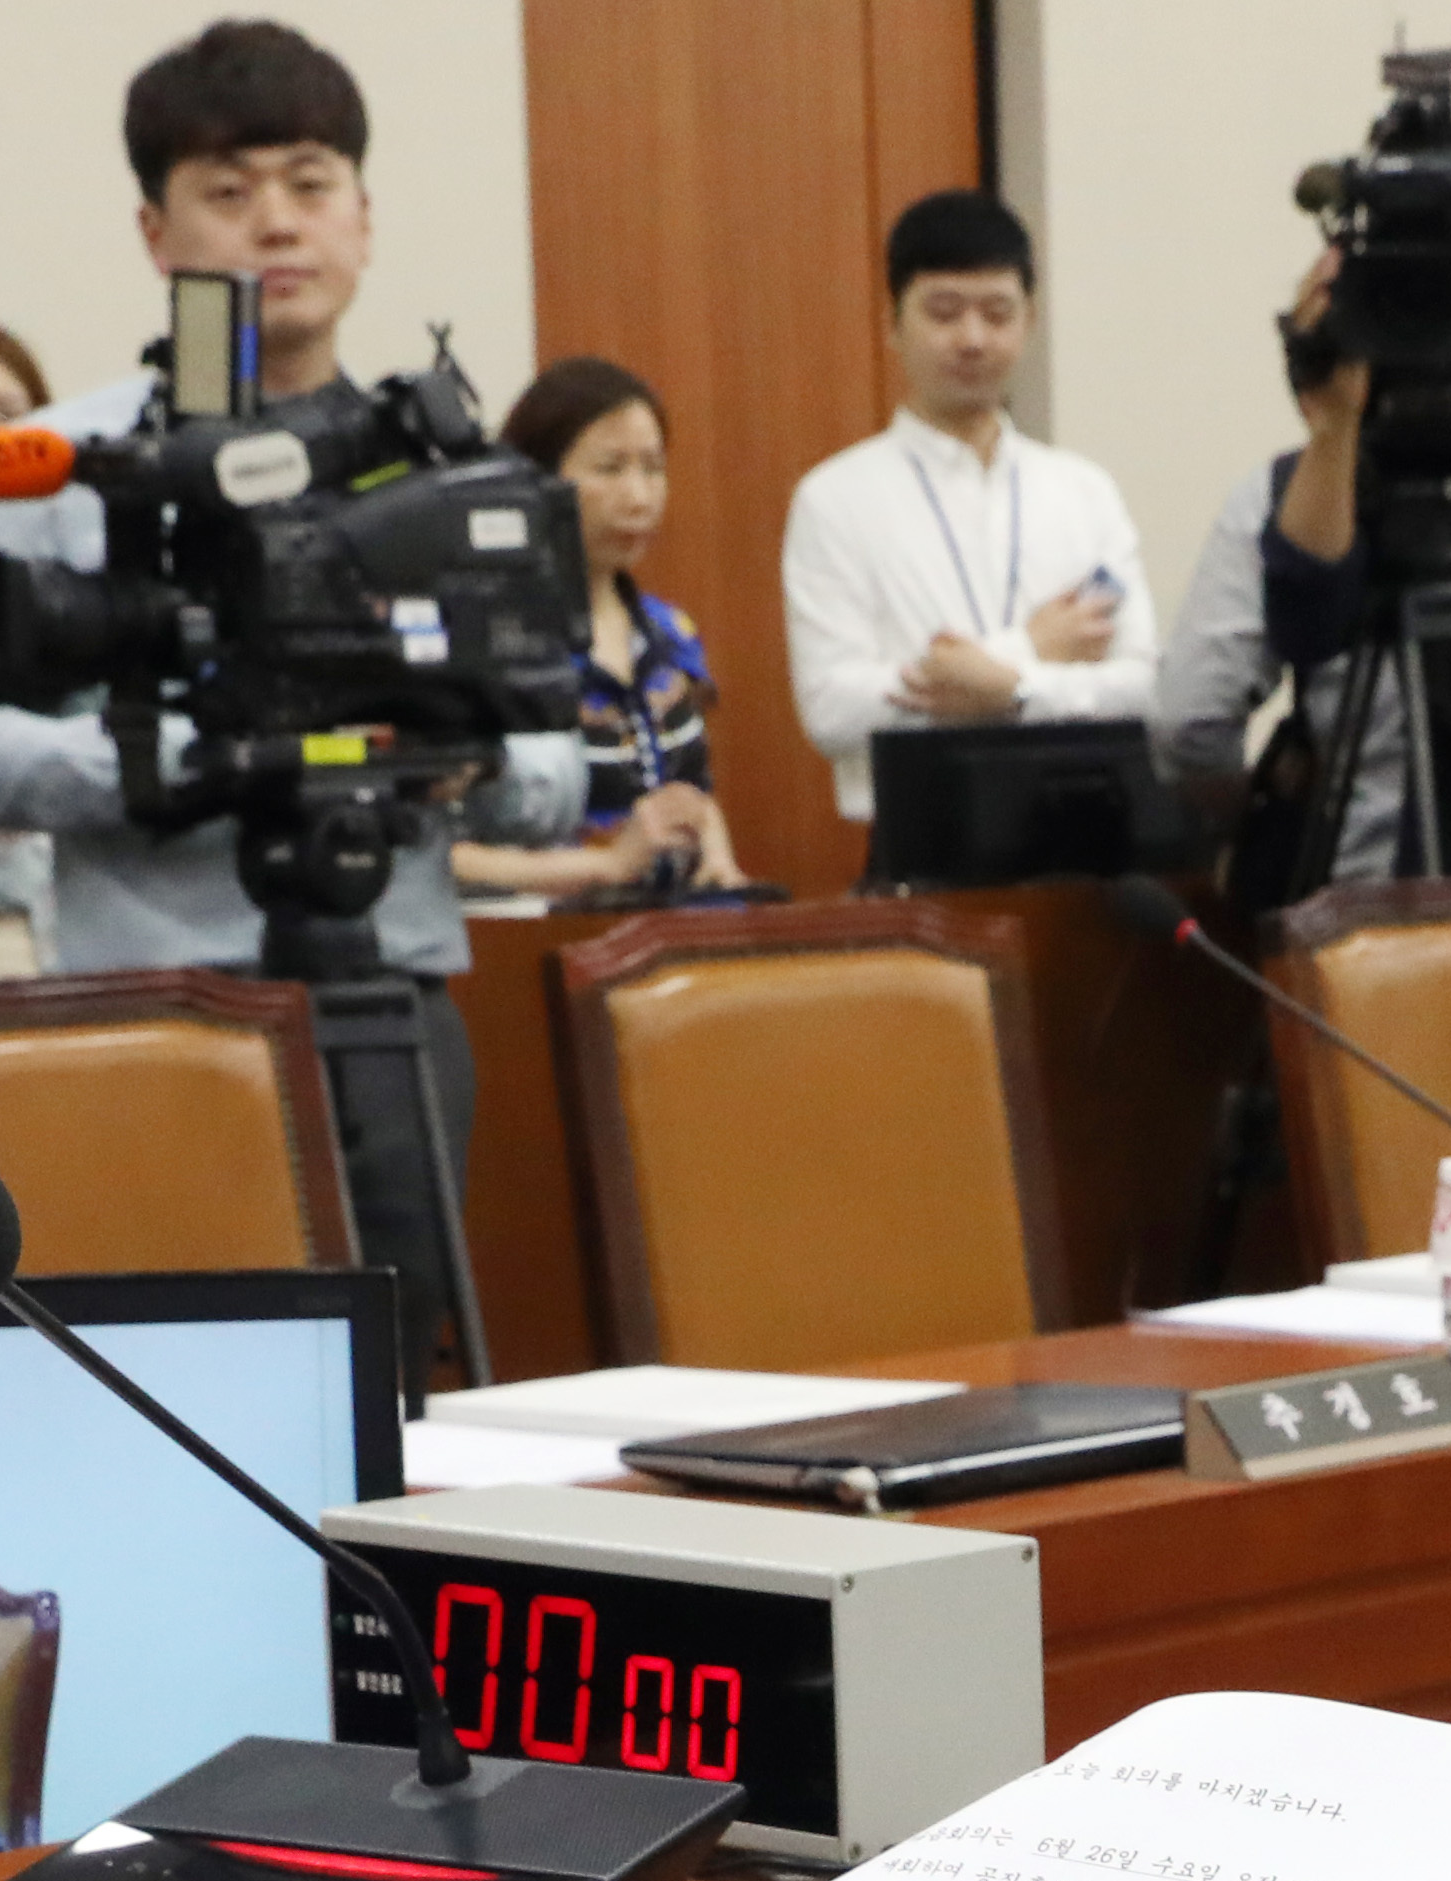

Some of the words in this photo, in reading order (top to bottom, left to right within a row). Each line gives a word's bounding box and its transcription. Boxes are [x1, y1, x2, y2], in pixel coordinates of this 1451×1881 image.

[621, 1653, 742, 1782] 00
[1054, 1761, 1101, 1779] 오늘
[1111, 1763, 1183, 1792] 회의를
[1198, 1778, 1347, 1823] 마치겠습니다.
[882, 1857, 964, 1878] 개회하여
[1037, 1836, 1077, 1859] 6월
[1085, 1845, 1138, 1871] 26일
